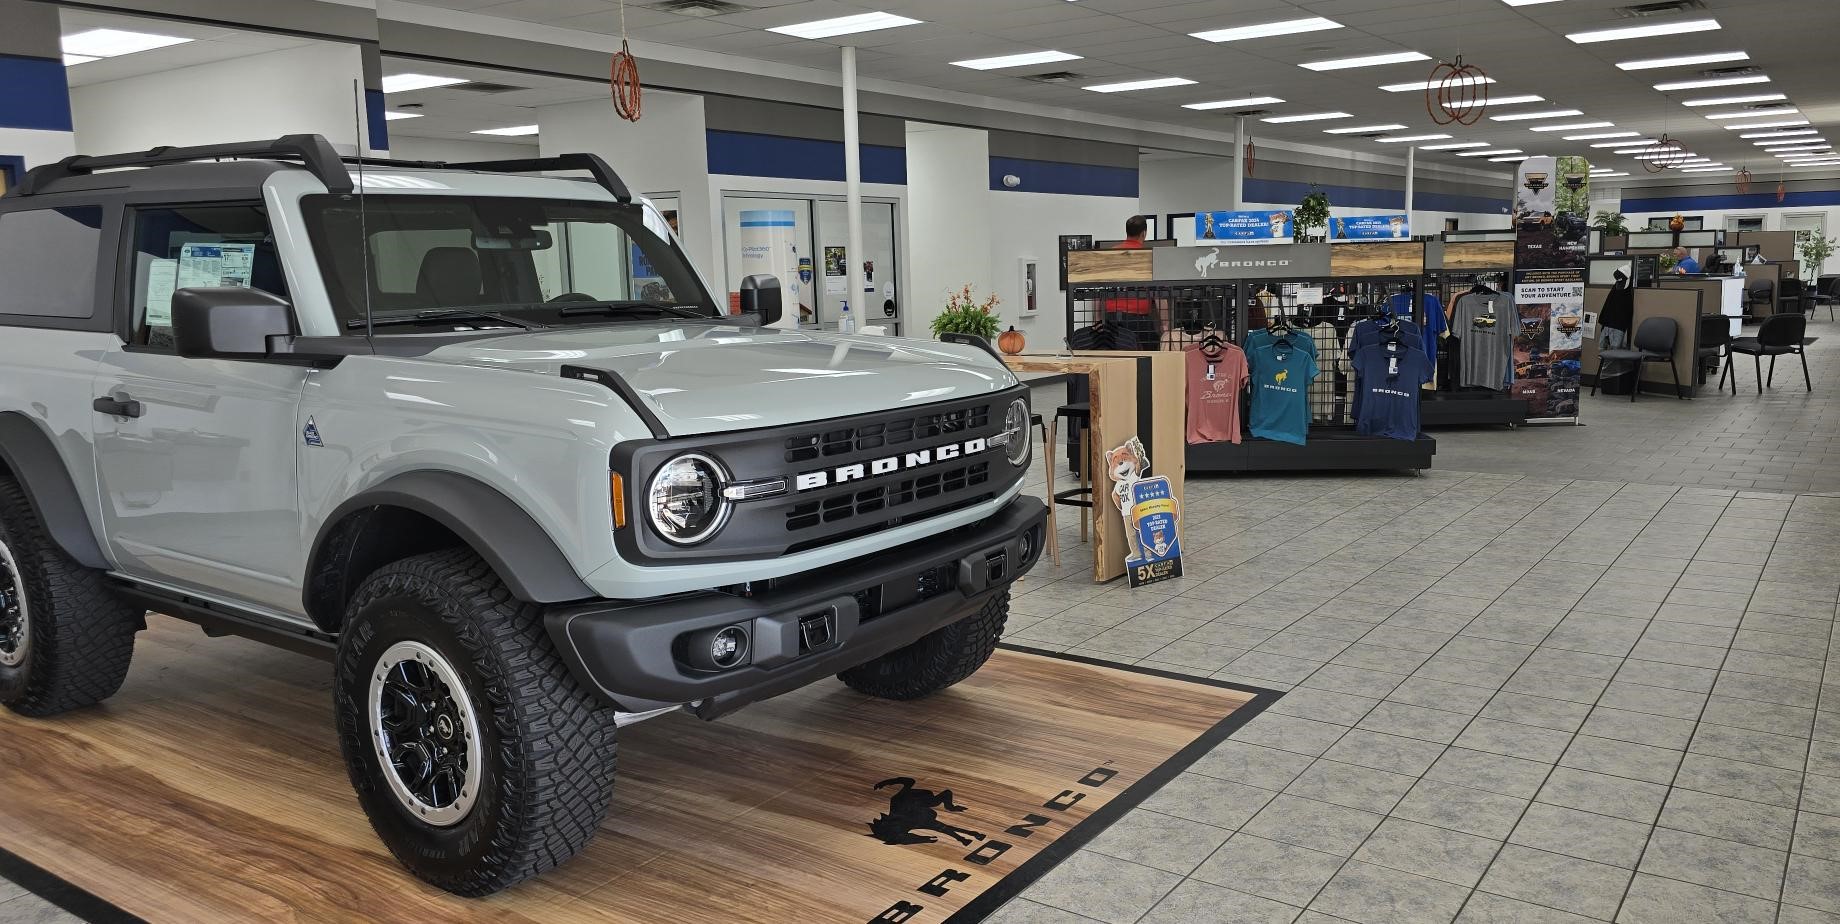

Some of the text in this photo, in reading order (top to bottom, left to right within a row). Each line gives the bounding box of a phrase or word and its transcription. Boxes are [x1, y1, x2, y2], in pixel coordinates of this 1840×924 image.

[1263, 384, 1297, 393] BRONCO
[1372, 388, 1410, 397] BRONCO
[796, 438, 987, 491] BRONCO
[1119, 483, 1130, 494] CAR
[1119, 492, 1130, 503] FOX
[1147, 519, 1168, 527] TOP-RATED
[1138, 563, 1156, 581] 5X
[866, 767, 1119, 924] BRONCO
